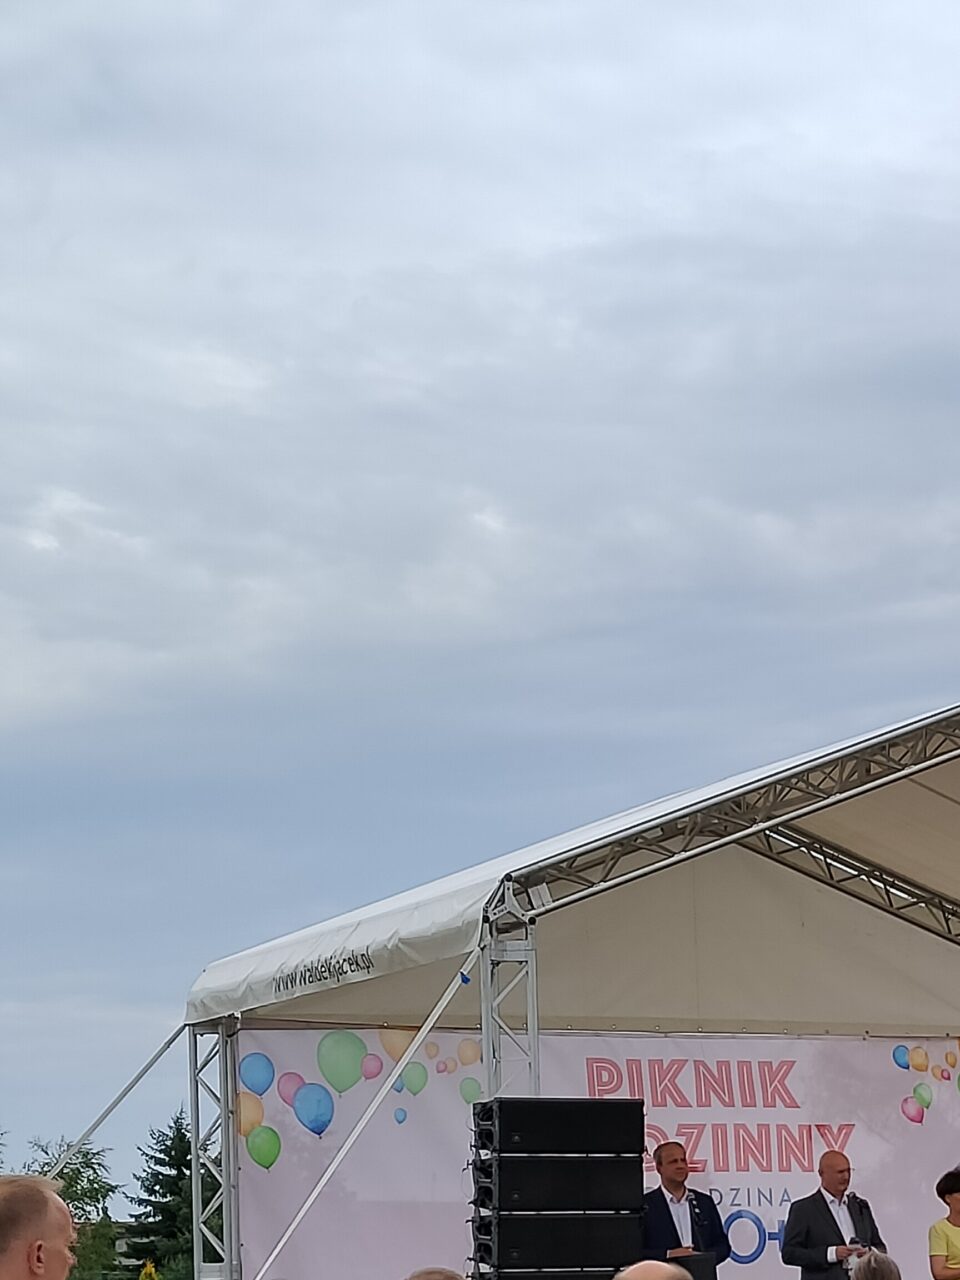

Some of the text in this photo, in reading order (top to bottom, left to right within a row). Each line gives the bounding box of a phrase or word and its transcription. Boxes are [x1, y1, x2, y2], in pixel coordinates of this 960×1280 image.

[585, 1057, 801, 1109] PIKNIK
[643, 1123, 856, 1173] DZINNY
[709, 1187, 793, 1208] DZINA
